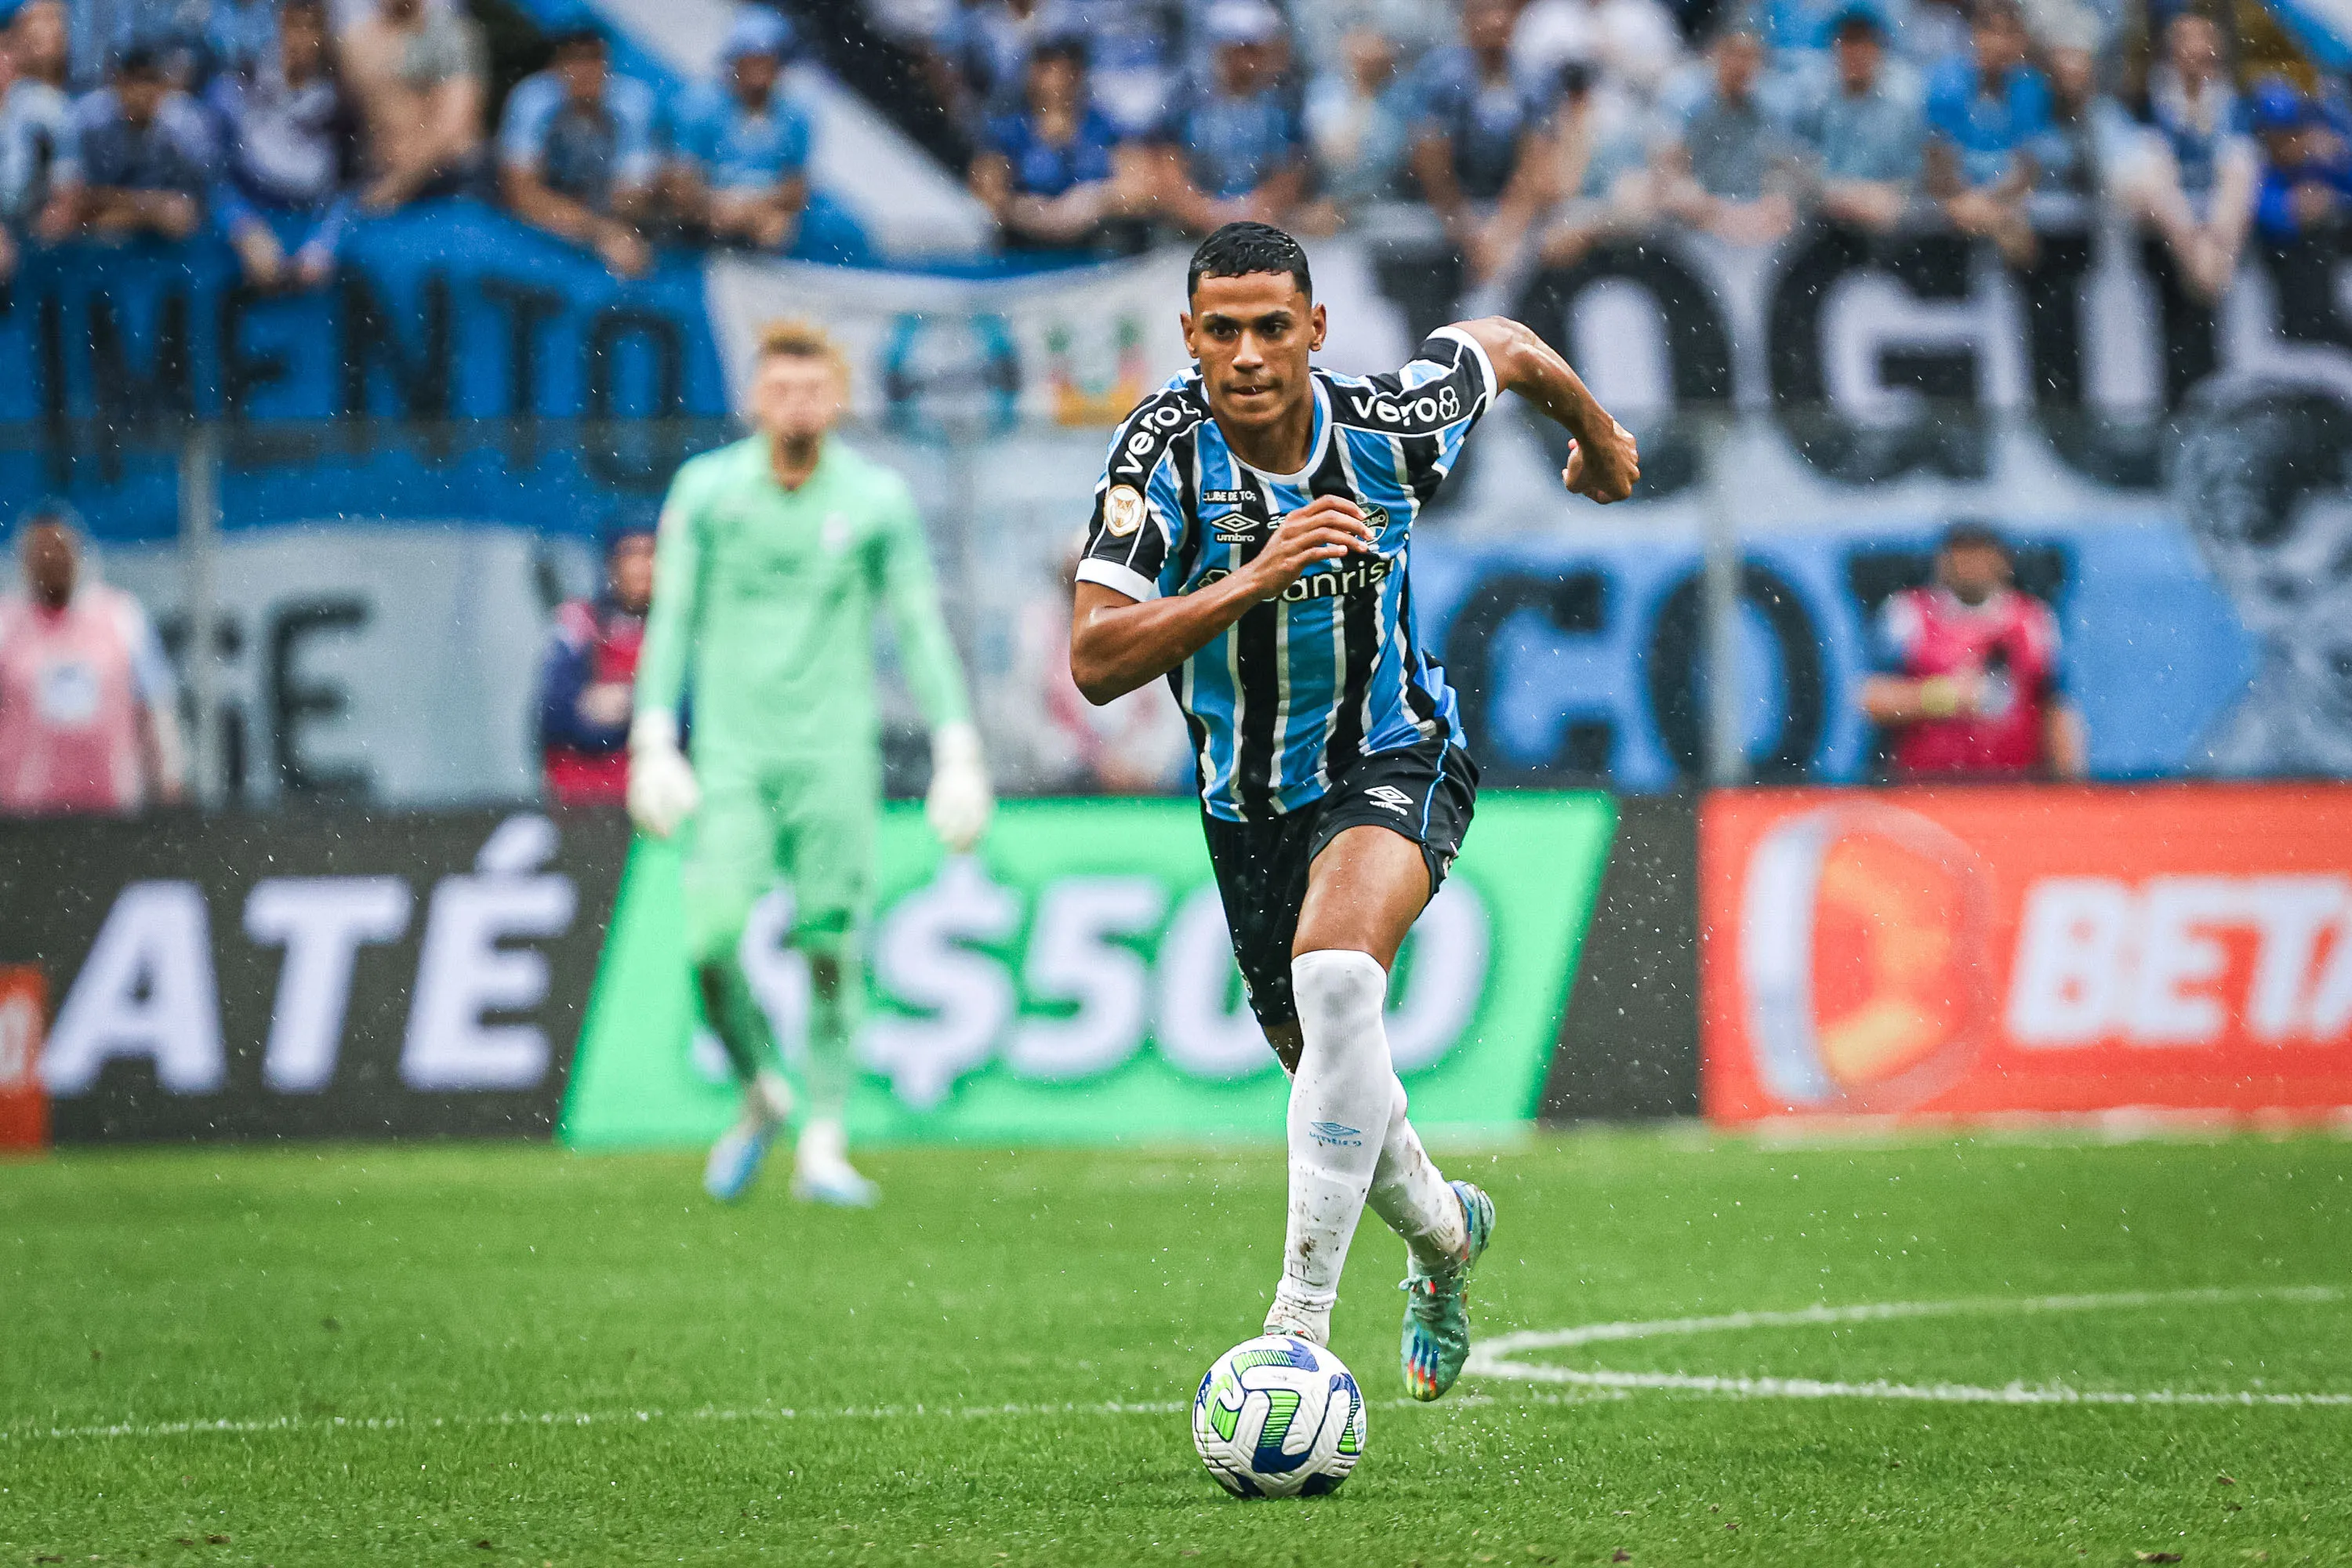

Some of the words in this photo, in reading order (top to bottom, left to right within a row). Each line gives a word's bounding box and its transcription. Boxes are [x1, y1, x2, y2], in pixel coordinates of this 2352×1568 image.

[0, 267, 690, 490] IMENTO
[1116, 406, 1181, 473] vero
[1228, 492, 1239, 502] DE
[1216, 533, 1255, 542] umbro
[38, 812, 579, 1095] ATÉ
